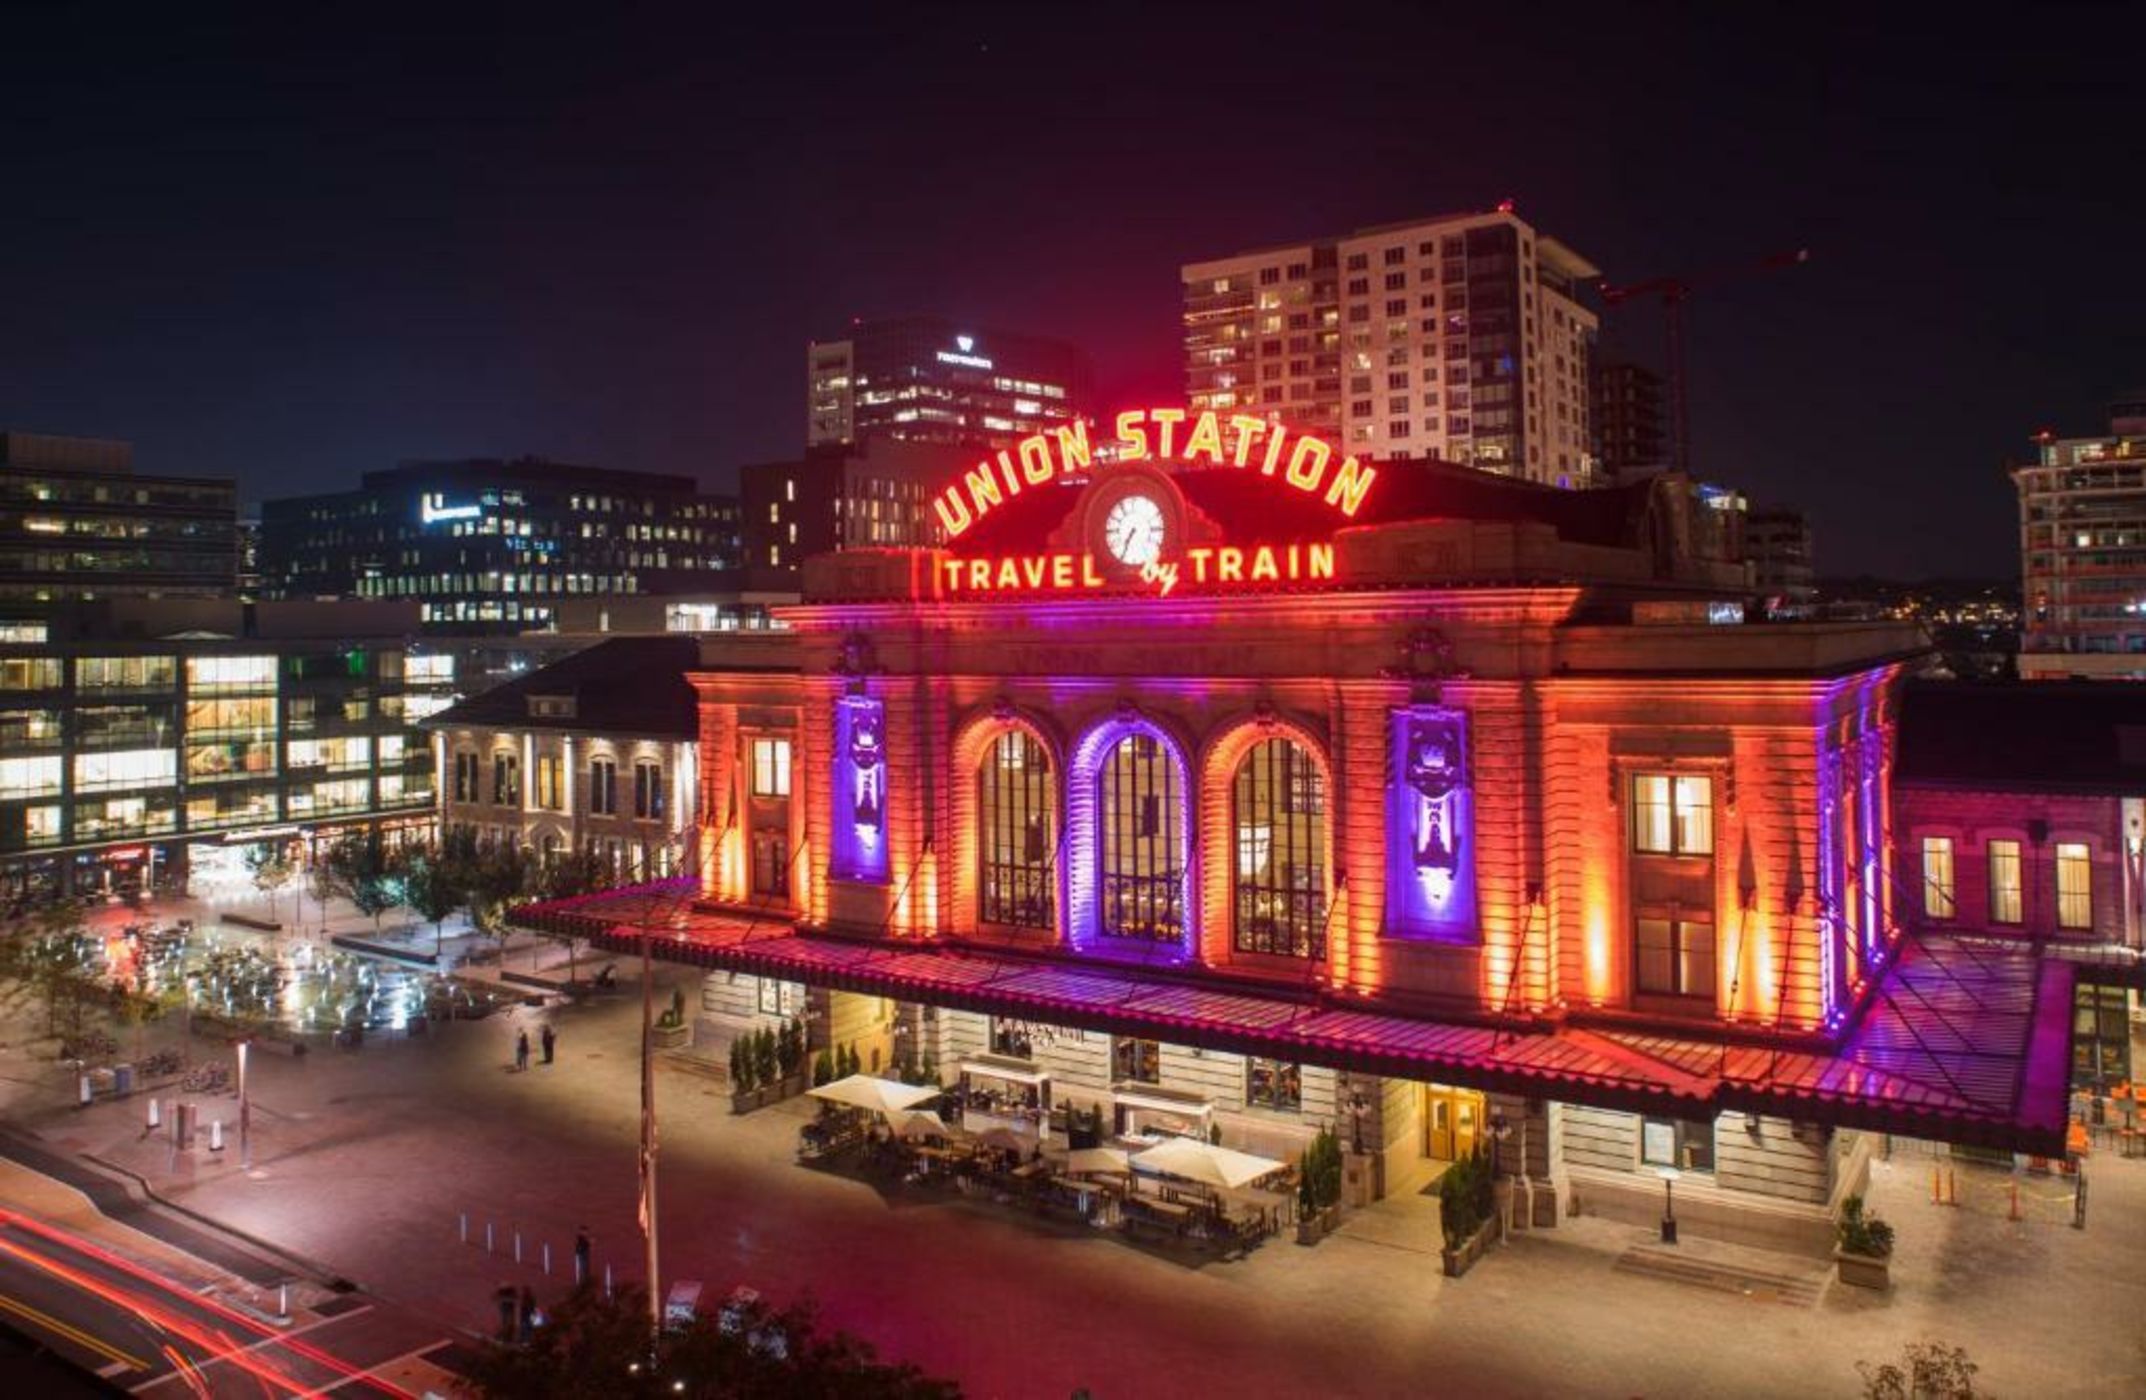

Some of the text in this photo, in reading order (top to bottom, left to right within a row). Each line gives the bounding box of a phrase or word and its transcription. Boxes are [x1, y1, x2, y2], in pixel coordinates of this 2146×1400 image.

[934, 408, 1376, 536] UNION STATION
[944, 544, 1335, 596] TRAVEL by TRAIN
